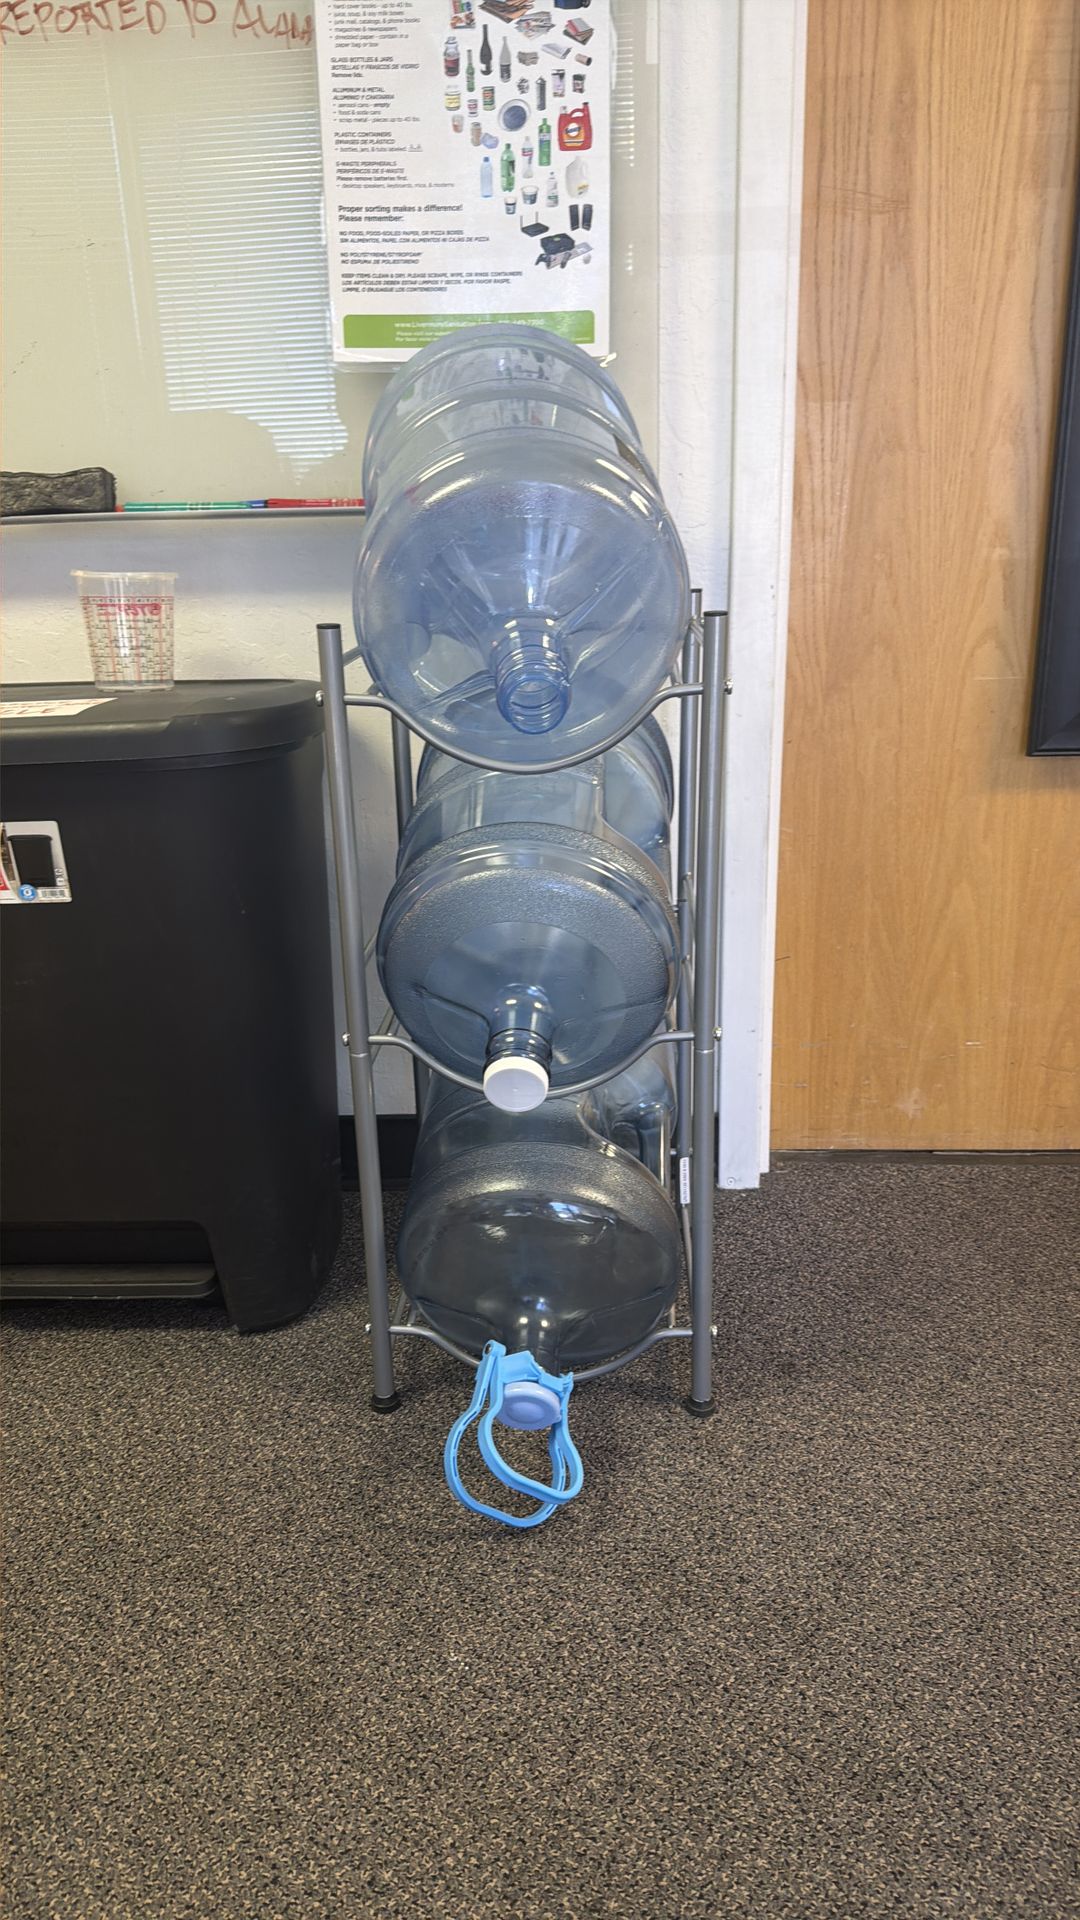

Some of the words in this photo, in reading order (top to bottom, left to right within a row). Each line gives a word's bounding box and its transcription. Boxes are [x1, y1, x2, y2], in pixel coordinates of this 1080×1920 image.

[0, 0, 166, 45] REPORTED
[177, 0, 217, 39] TO
[338, 205, 363, 213] Proper
[364, 205, 391, 213] sorting
